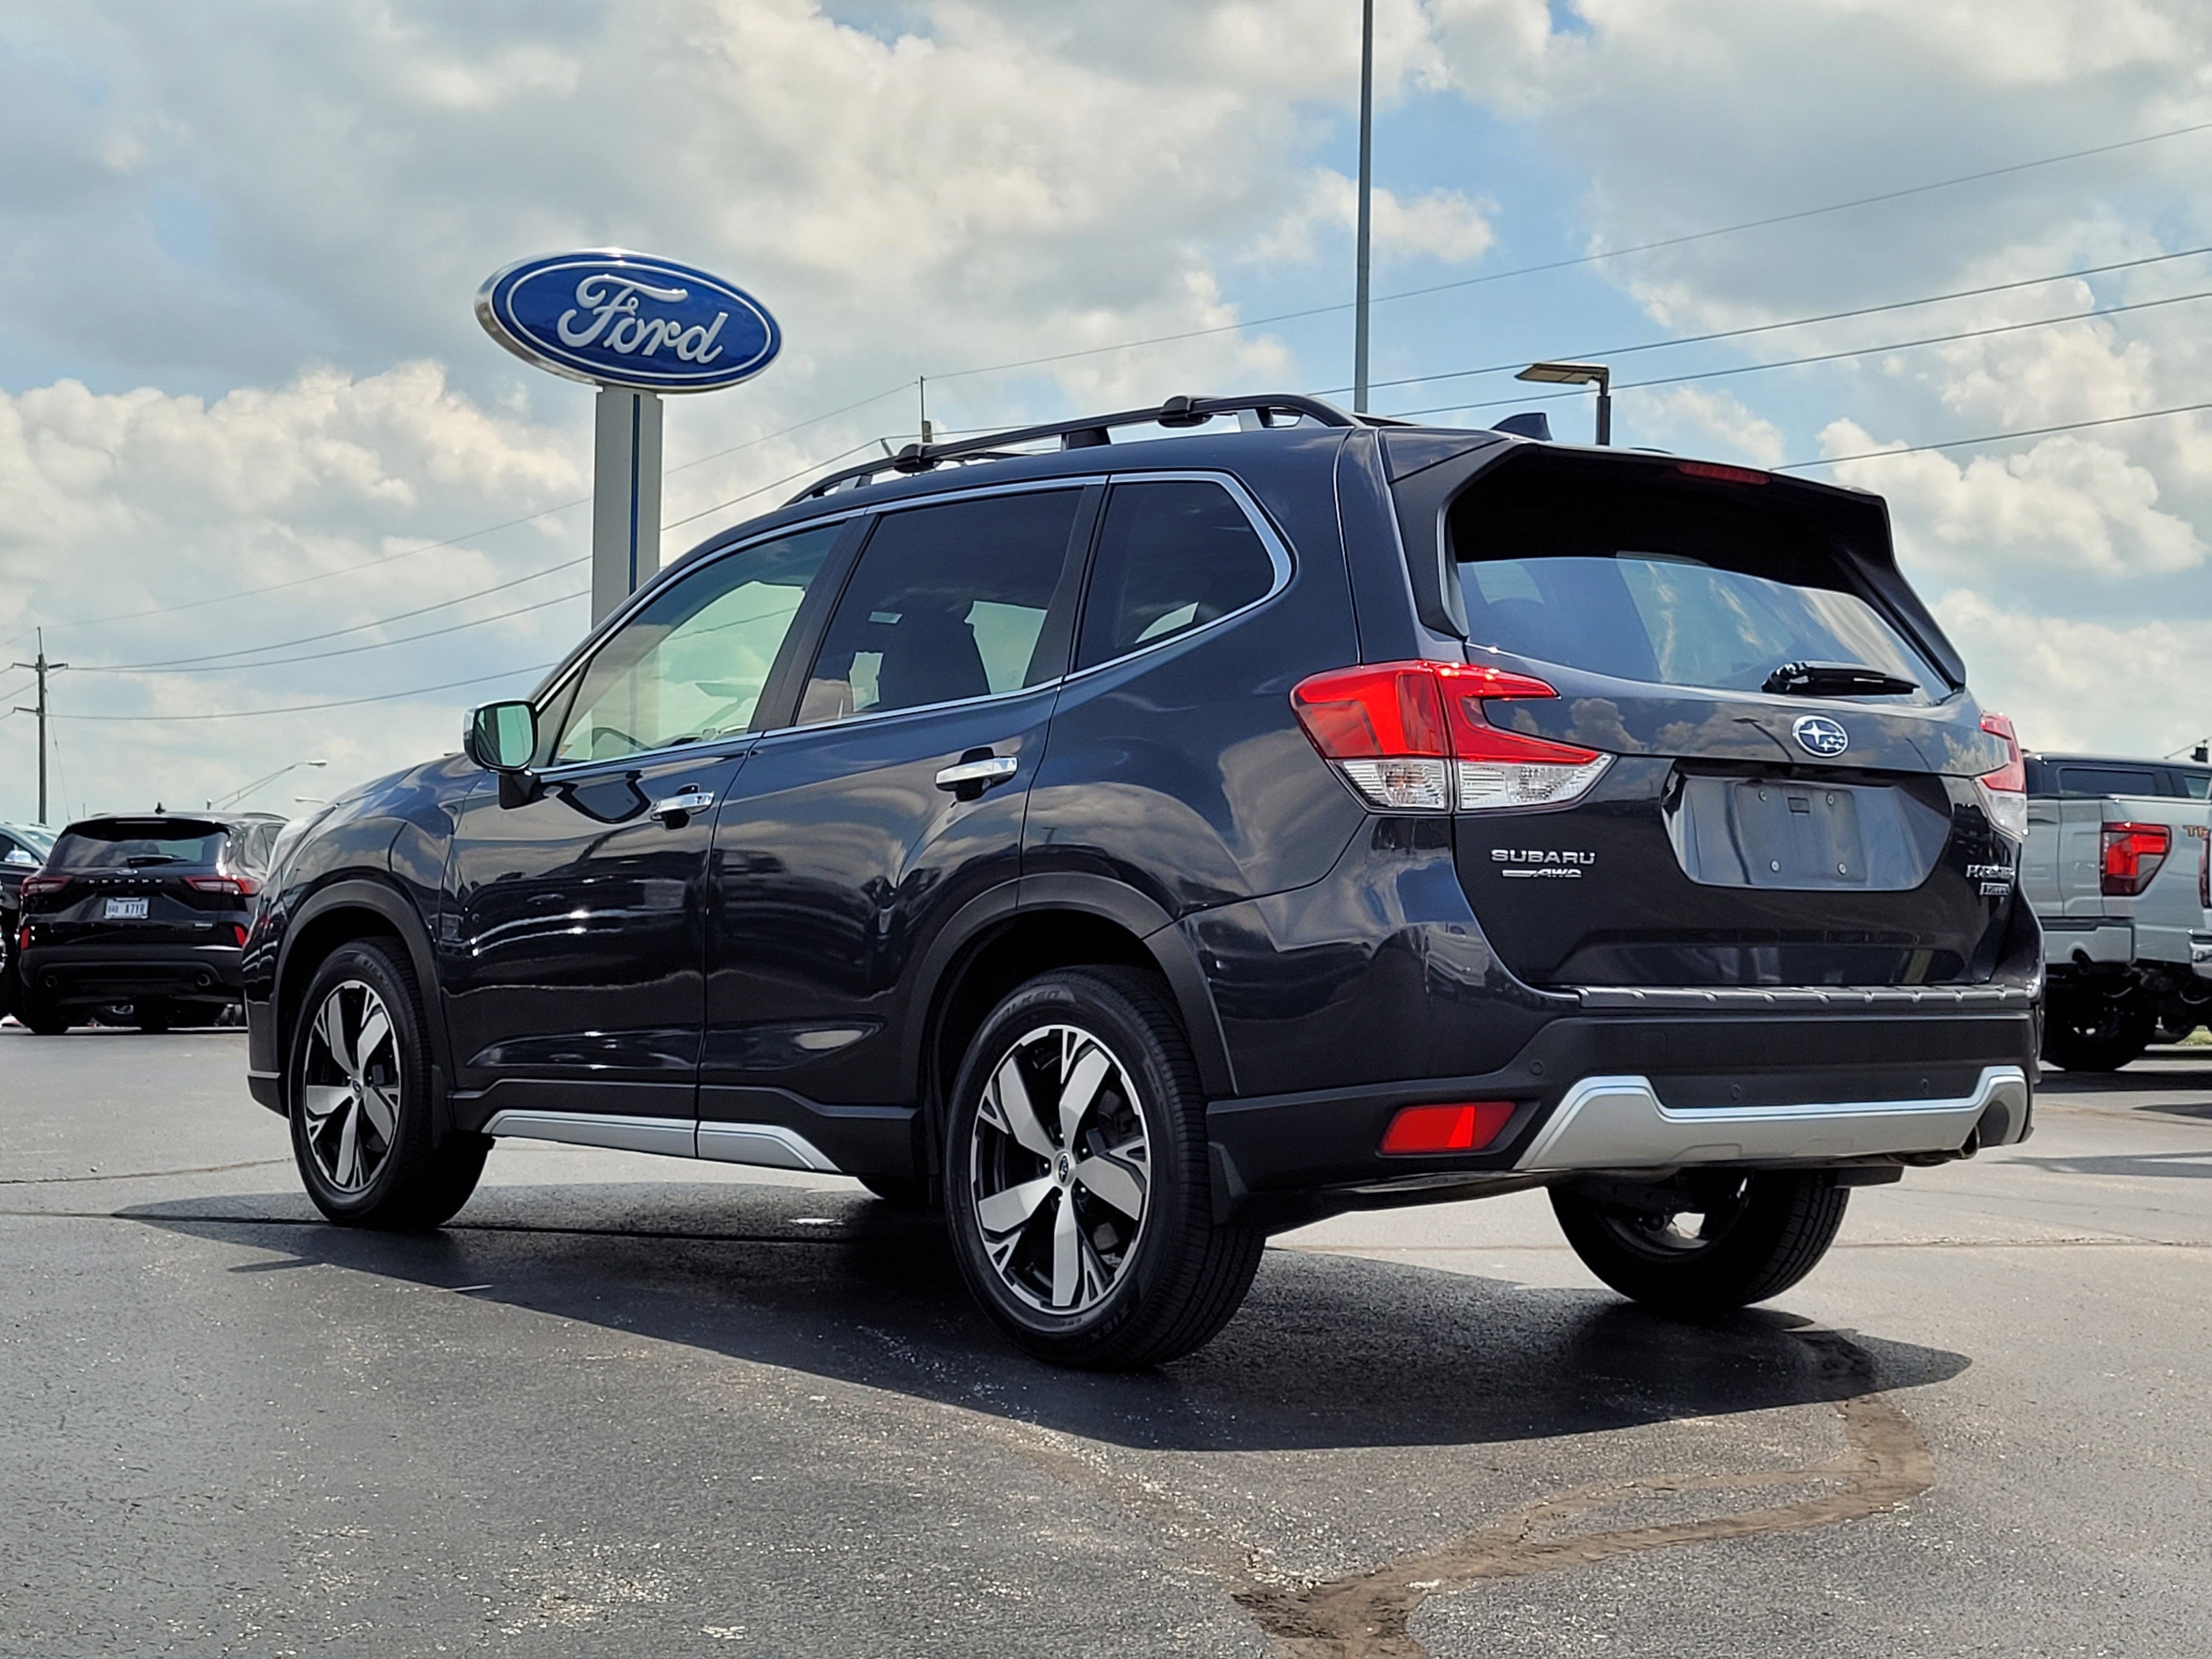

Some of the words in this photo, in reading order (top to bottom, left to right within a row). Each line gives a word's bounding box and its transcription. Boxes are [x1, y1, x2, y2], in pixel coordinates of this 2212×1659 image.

[557, 274, 728, 363] Ford
[1491, 849, 1595, 865] SUBARU
[1532, 868, 1582, 878] AWD
